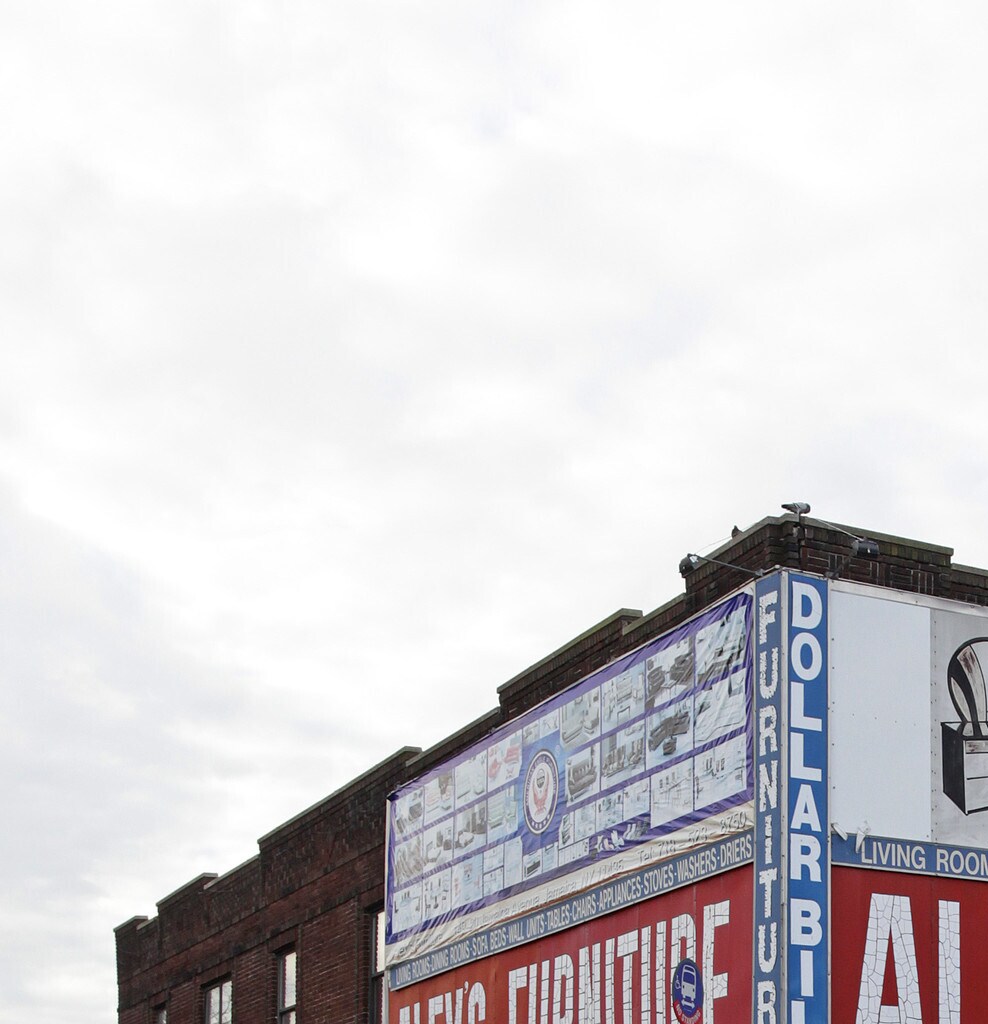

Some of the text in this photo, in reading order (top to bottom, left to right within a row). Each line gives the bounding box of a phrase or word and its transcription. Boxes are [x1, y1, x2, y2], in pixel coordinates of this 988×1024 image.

[790, 581, 823, 882] DOLLAR
[432, 948, 449, 970] DINING
[450, 940, 470, 965] ROOMS
[472, 934, 488, 955] SOFA
[490, 926, 506, 947] BEDS
[509, 920, 524, 941] WALL
[527, 914, 545, 937] UNITS
[547, 904, 570, 930] TABLES
[572, 893, 596, 922] CHAIRS
[599, 876, 641, 908] APPLIANCES
[643, 864, 674, 893] STOVES
[676, 848, 717, 882] WASHERS
[720, 834, 752, 864] DRIERS
[861, 841, 926, 869] LIVING
